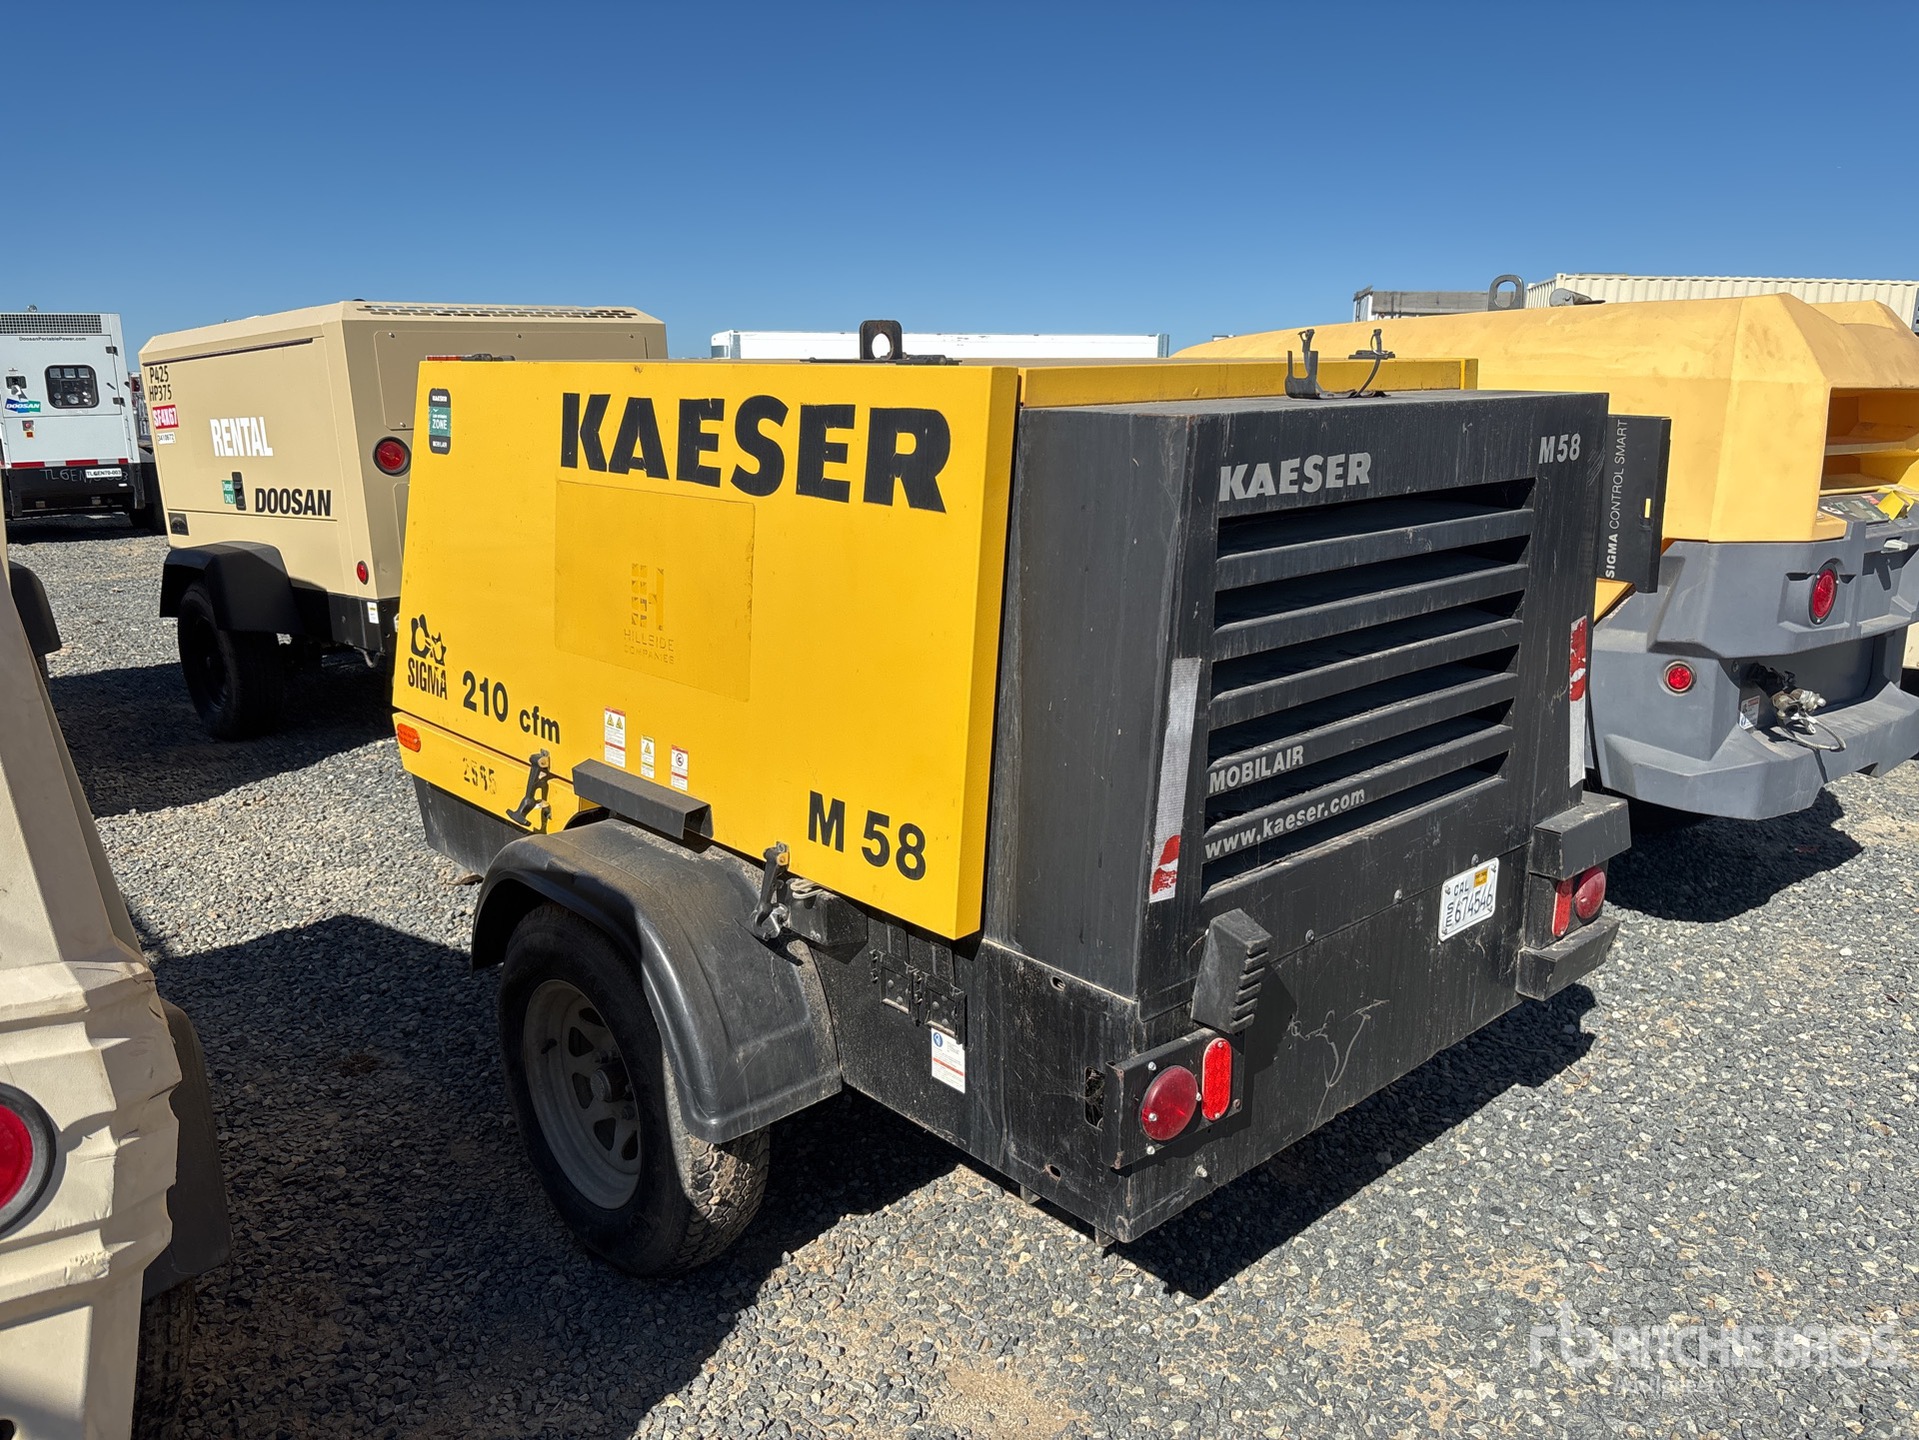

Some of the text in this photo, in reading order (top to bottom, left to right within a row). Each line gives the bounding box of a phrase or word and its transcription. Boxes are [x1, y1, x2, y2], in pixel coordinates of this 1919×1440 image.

[149, 365, 169, 383] P425
[149, 384, 172, 401] HP375
[209, 416, 274, 457] RENTAL
[432, 419, 448, 430] ZONE
[560, 392, 951, 515] KAESER
[1218, 451, 1372, 502] KAESER
[255, 487, 332, 517] DOOSAN
[1605, 419, 1628, 579] SIGMA CONTROL SMART
[623, 628, 674, 652] HILLSIDE
[407, 656, 448, 700] SIGMA
[462, 670, 509, 723] 210
[519, 705, 560, 745] cfm
[1209, 745, 1304, 794] MOBILAIR
[807, 789, 927, 881] M 58
[1205, 788, 1365, 860] www.kaeser.com
[1453, 880, 1469, 897] CAL
[1454, 883, 1493, 924] 674546
